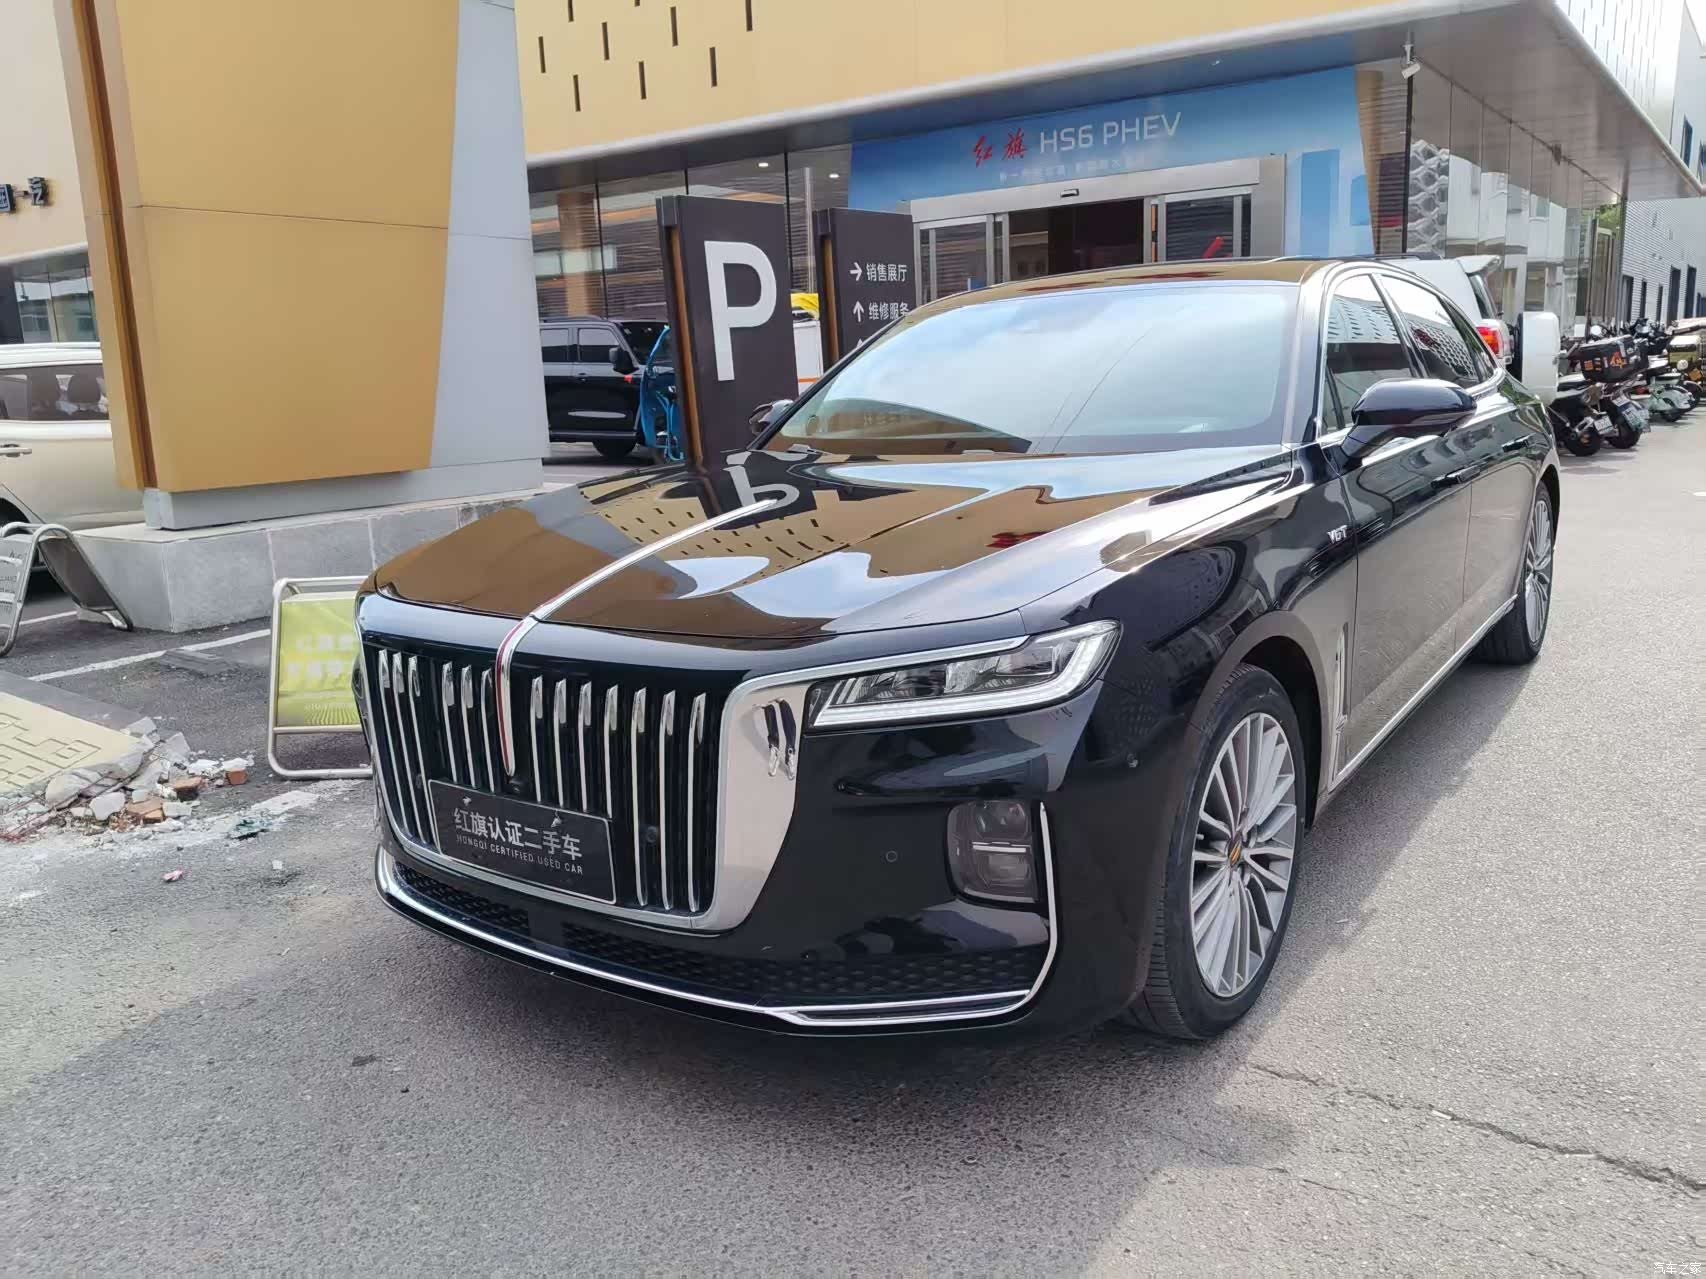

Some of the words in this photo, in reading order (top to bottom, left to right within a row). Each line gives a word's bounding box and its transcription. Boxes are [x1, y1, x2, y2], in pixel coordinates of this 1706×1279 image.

[974, 127, 1027, 168] 红旗
[1040, 125, 1094, 153] HS6
[1103, 111, 1181, 145] PHEV
[866, 263, 908, 282] 销售展厅
[704, 240, 777, 381] P
[453, 807, 583, 861] 红旗认证二手车
[456, 834, 488, 850] HONGQI
[490, 844, 534, 863] CERTIFIED
[537, 855, 561, 869] USED
[564, 862, 583, 875] CAR
